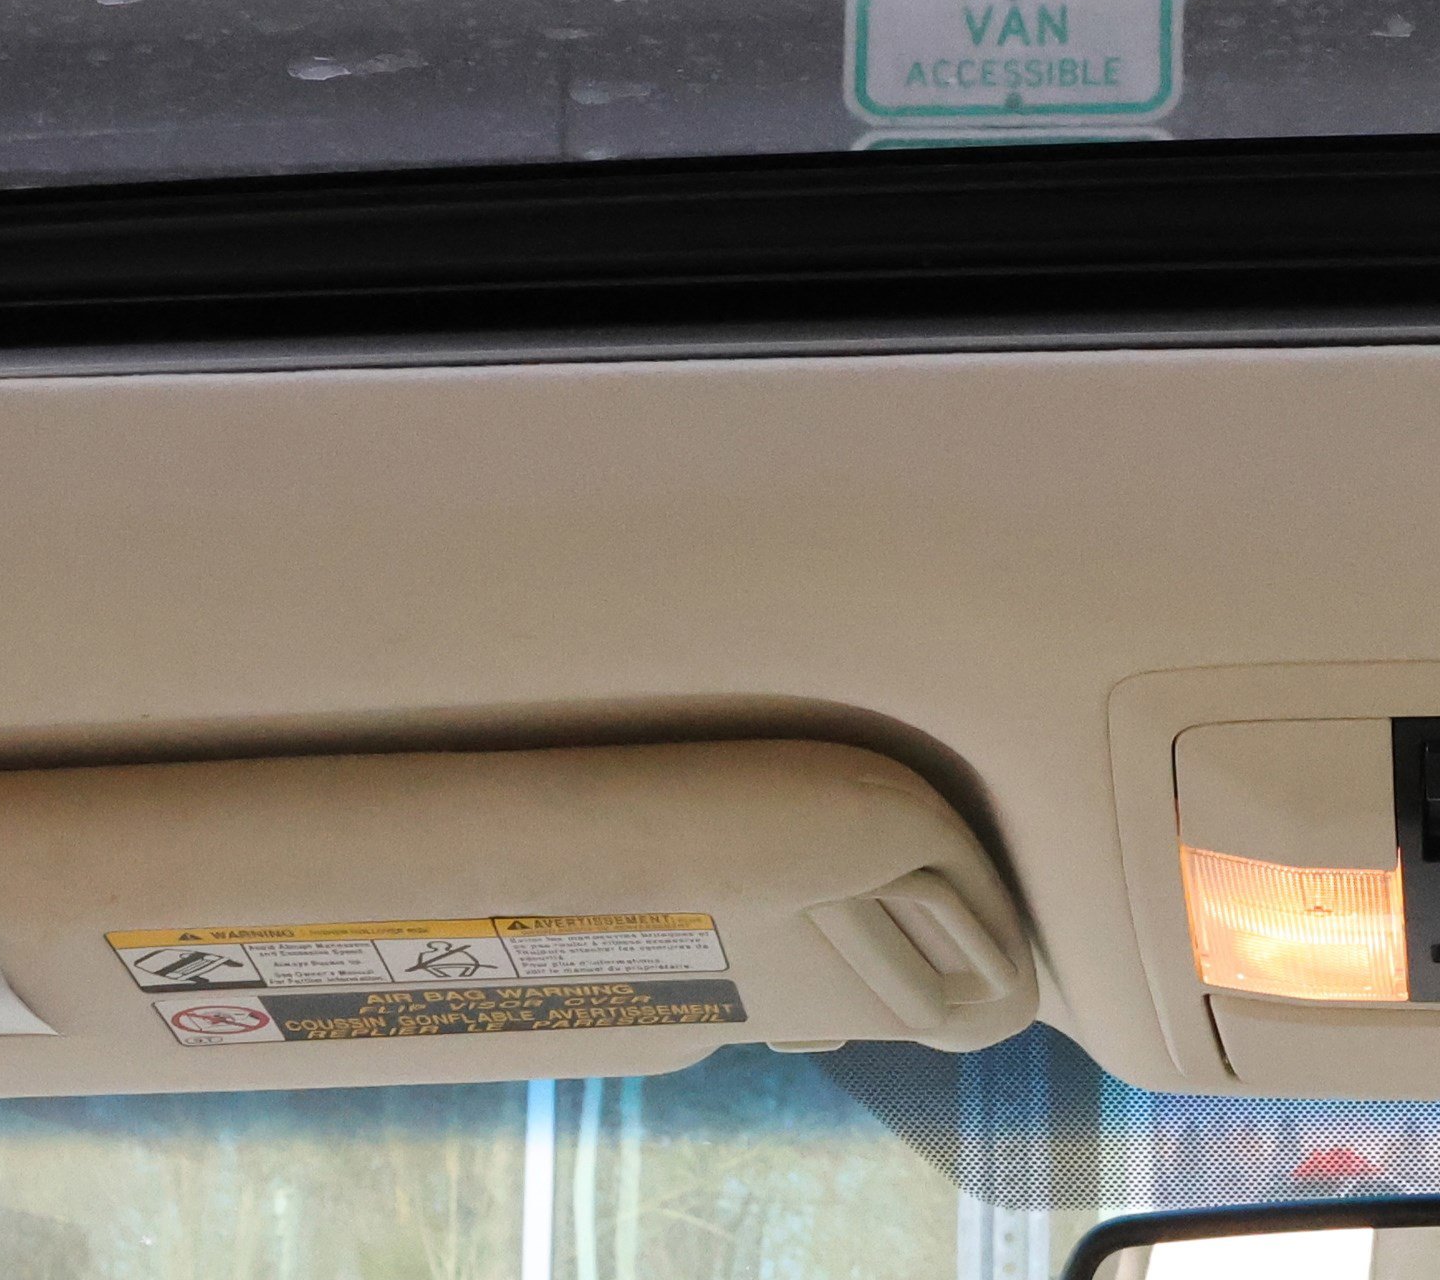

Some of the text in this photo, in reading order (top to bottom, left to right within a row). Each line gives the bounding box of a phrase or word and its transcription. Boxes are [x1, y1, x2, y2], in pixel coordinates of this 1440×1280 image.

[964, 4, 1070, 47] VAN
[904, 56, 1122, 89] ACCESSIBLE
[534, 915, 672, 929] AVERTISSEMENT
[210, 929, 294, 939] WARNING
[358, 996, 651, 1013] FLIP VISOR OVER
[364, 985, 632, 1003] AIR BAG WARNING
[285, 1002, 733, 1030] COUSSIN GONFLABLE AVERTISSEMENT
[306, 1027, 440, 1038] REPLIER
[531, 1014, 724, 1027] PARESOLEIL
